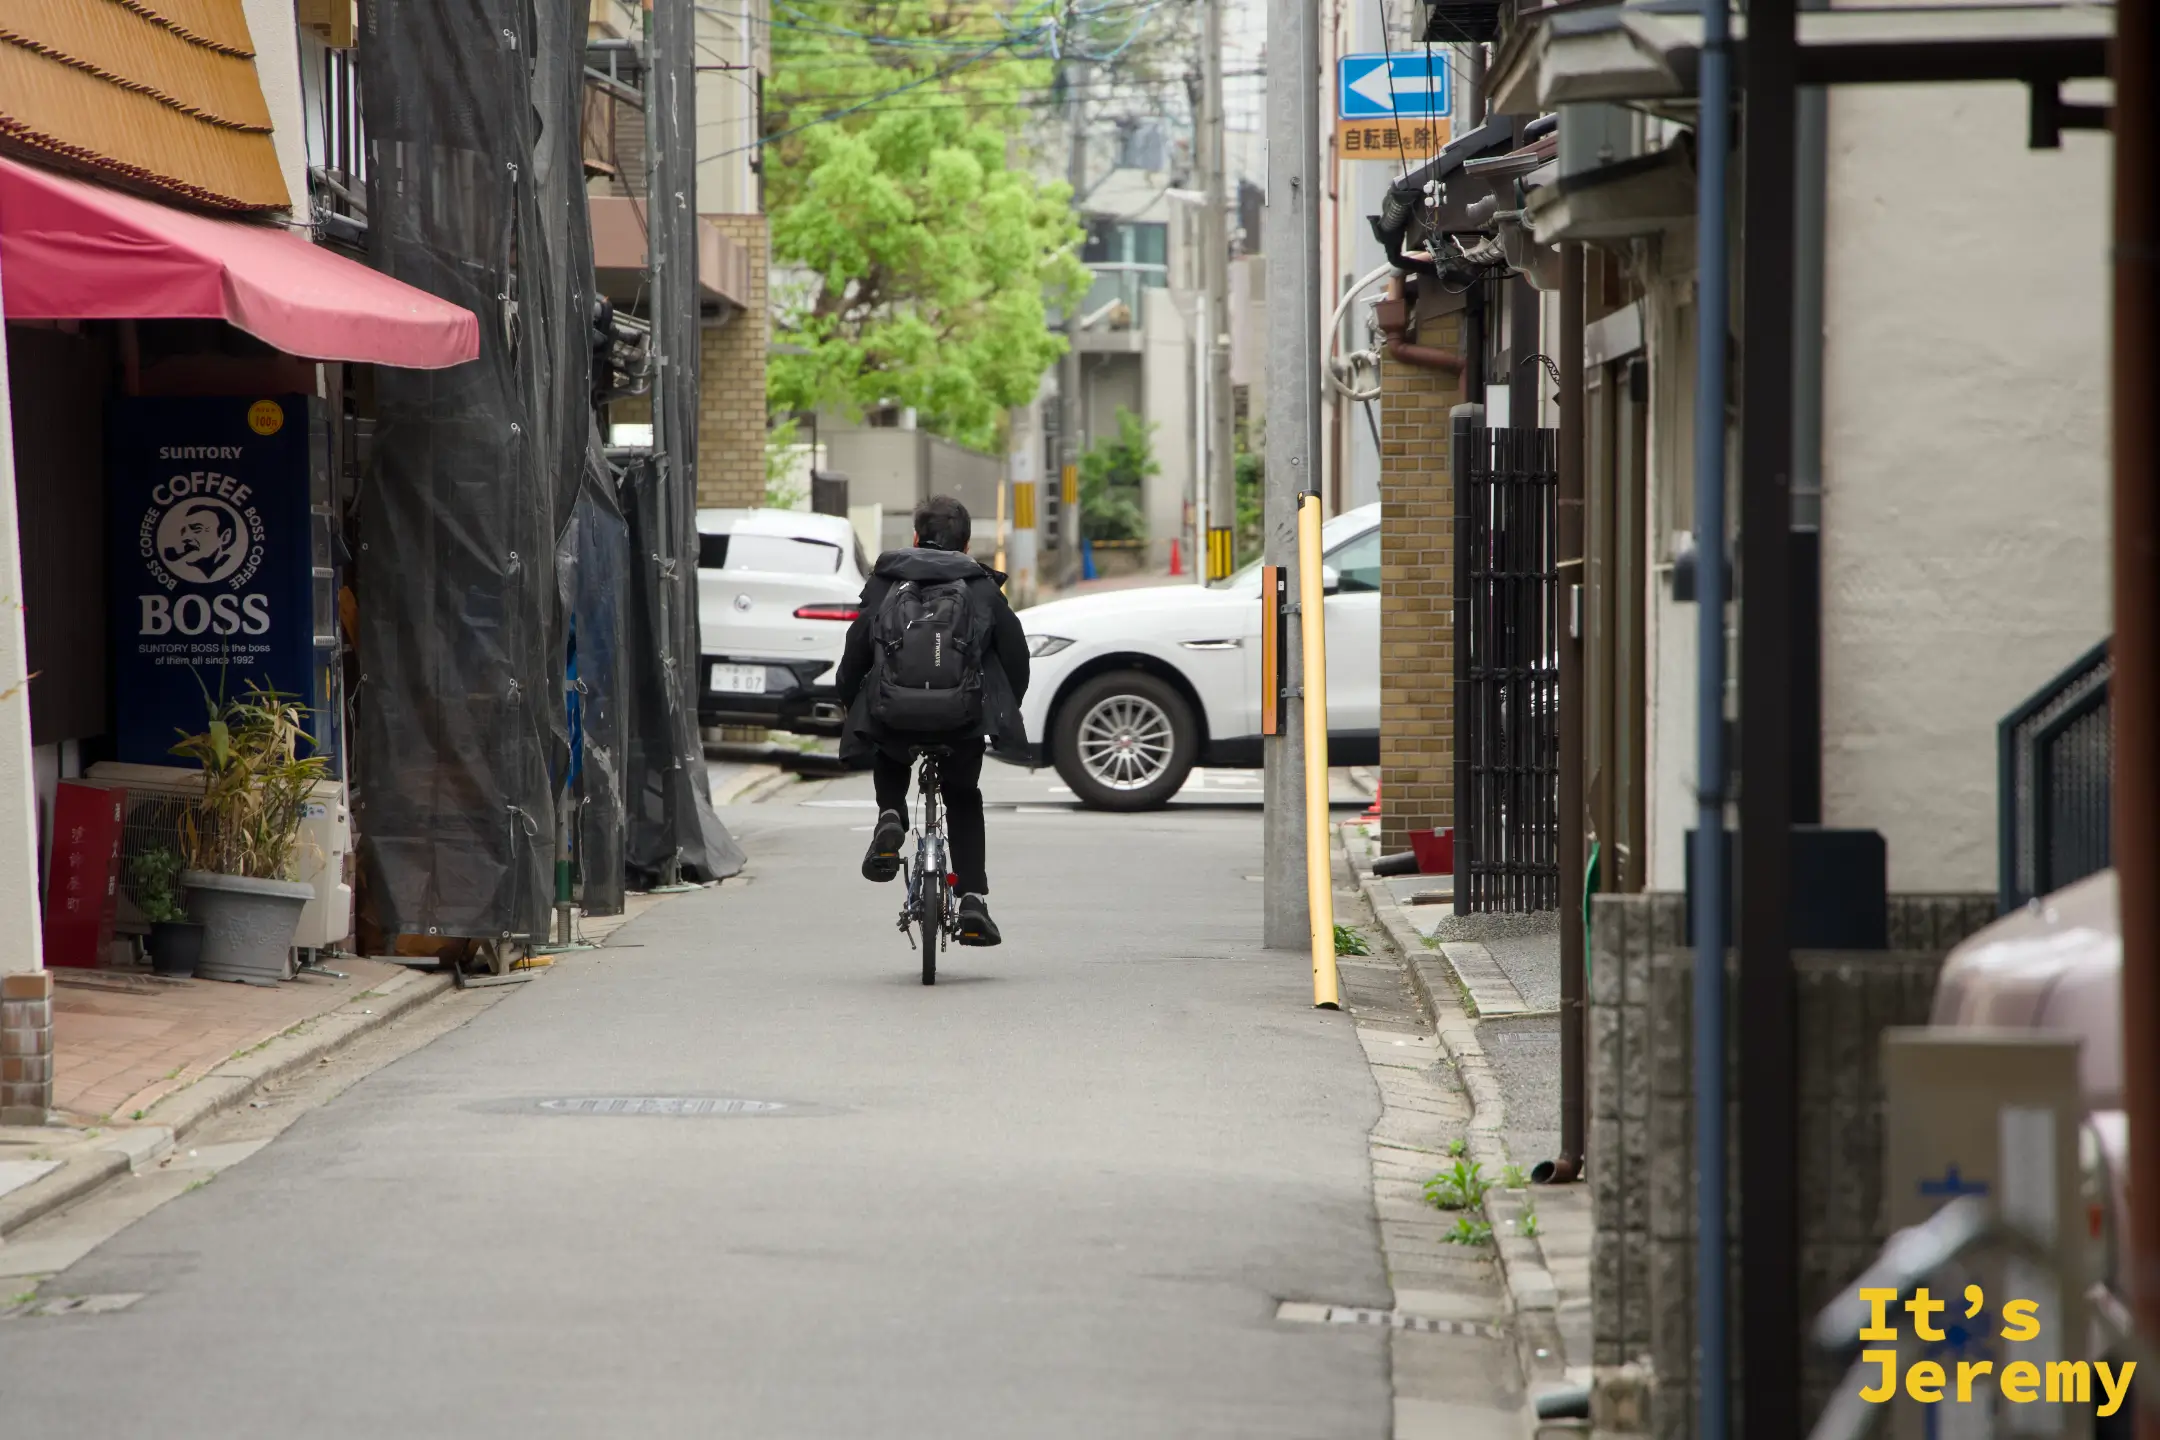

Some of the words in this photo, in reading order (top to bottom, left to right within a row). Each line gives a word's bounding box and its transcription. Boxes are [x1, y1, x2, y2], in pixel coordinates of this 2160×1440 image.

[1345, 127, 1444, 151] 自転車を除く
[159, 446, 243, 459] SUNTORY
[152, 471, 253, 506] COFFEE
[140, 506, 160, 558] COFFEE
[244, 506, 265, 542] BOSS
[146, 559, 178, 591] BOSS
[228, 545, 264, 590] COFFEE
[138, 594, 270, 635] BOSS
[138, 644, 188, 653] SUNTORY
[190, 644, 219, 653] BOSS
[231, 644, 246, 653] the
[248, 644, 271, 653] boss
[155, 656, 165, 665] of
[166, 656, 189, 665] them
[191, 656, 203, 665] all
[204, 656, 230, 665] since
[232, 656, 254, 665] 1992
